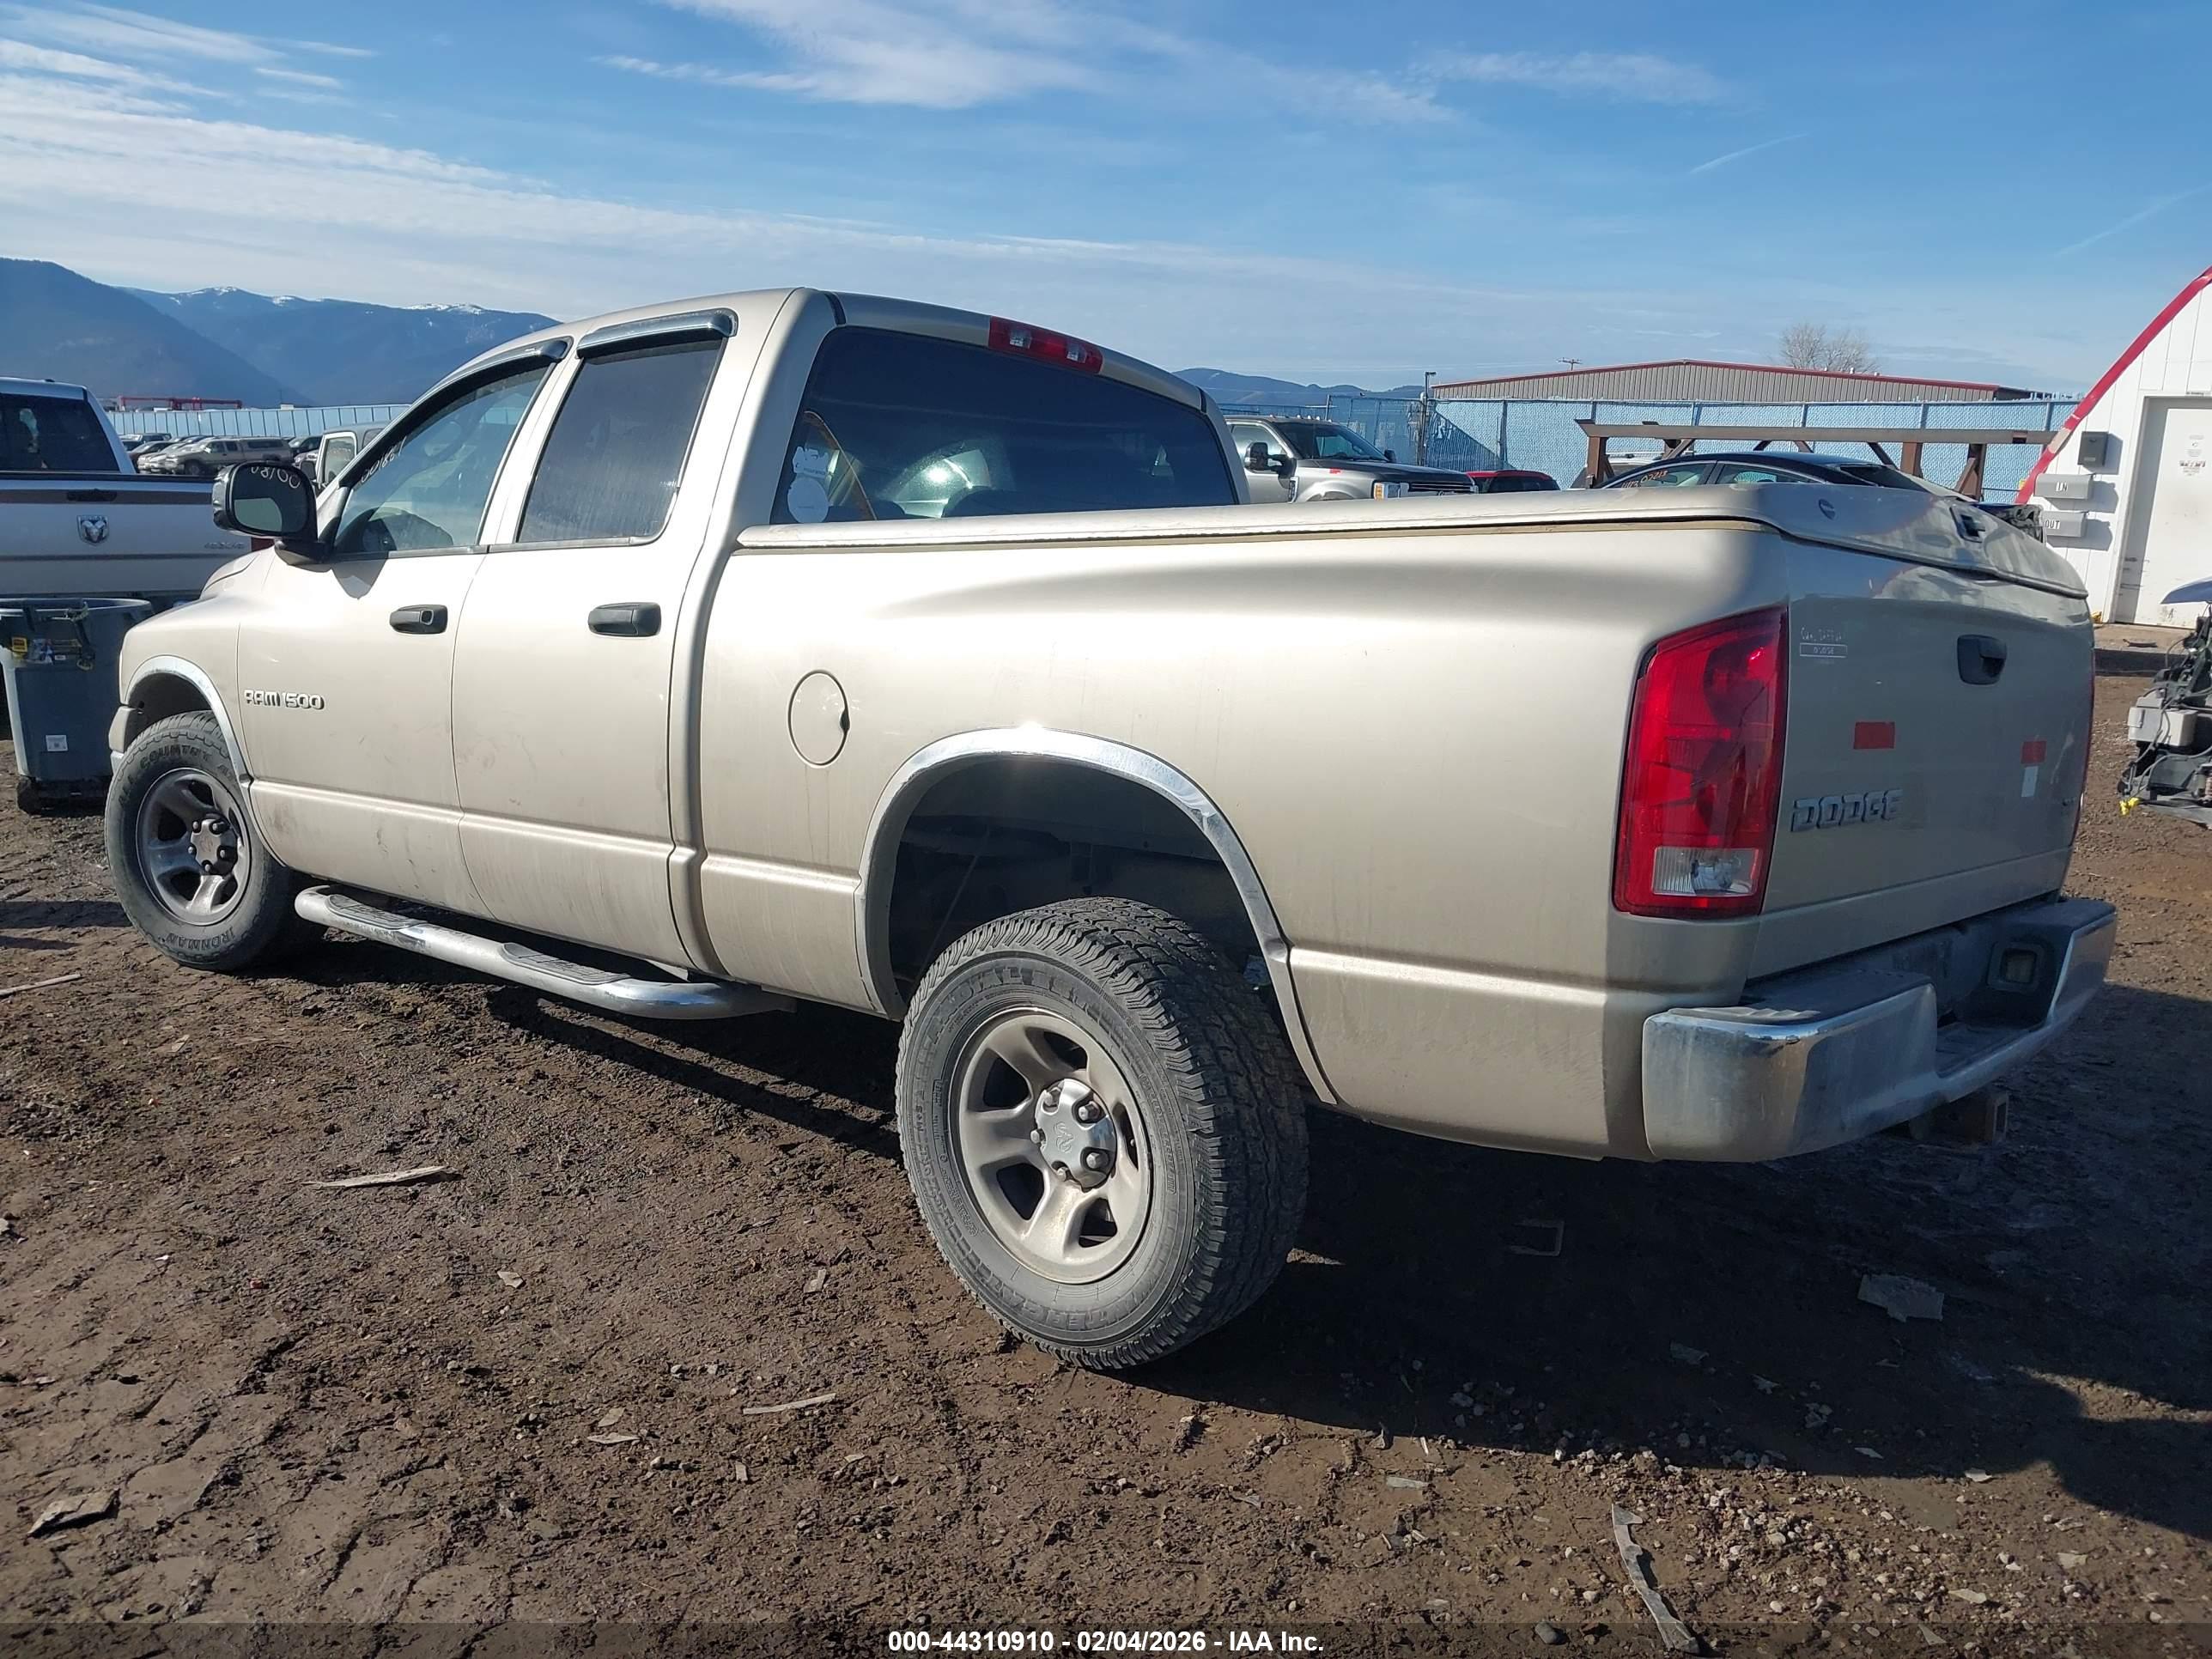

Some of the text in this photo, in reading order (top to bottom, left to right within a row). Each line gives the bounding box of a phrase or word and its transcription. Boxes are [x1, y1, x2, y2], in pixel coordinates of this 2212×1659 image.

[2057, 482, 2069, 492] IN
[2045, 520, 2060, 529] OUT
[244, 690, 325, 710] RAM 1500
[140, 744, 212, 770] COUNTRY
[1790, 787, 1904, 832] DODGE
[166, 926, 235, 949] IRONMAN
